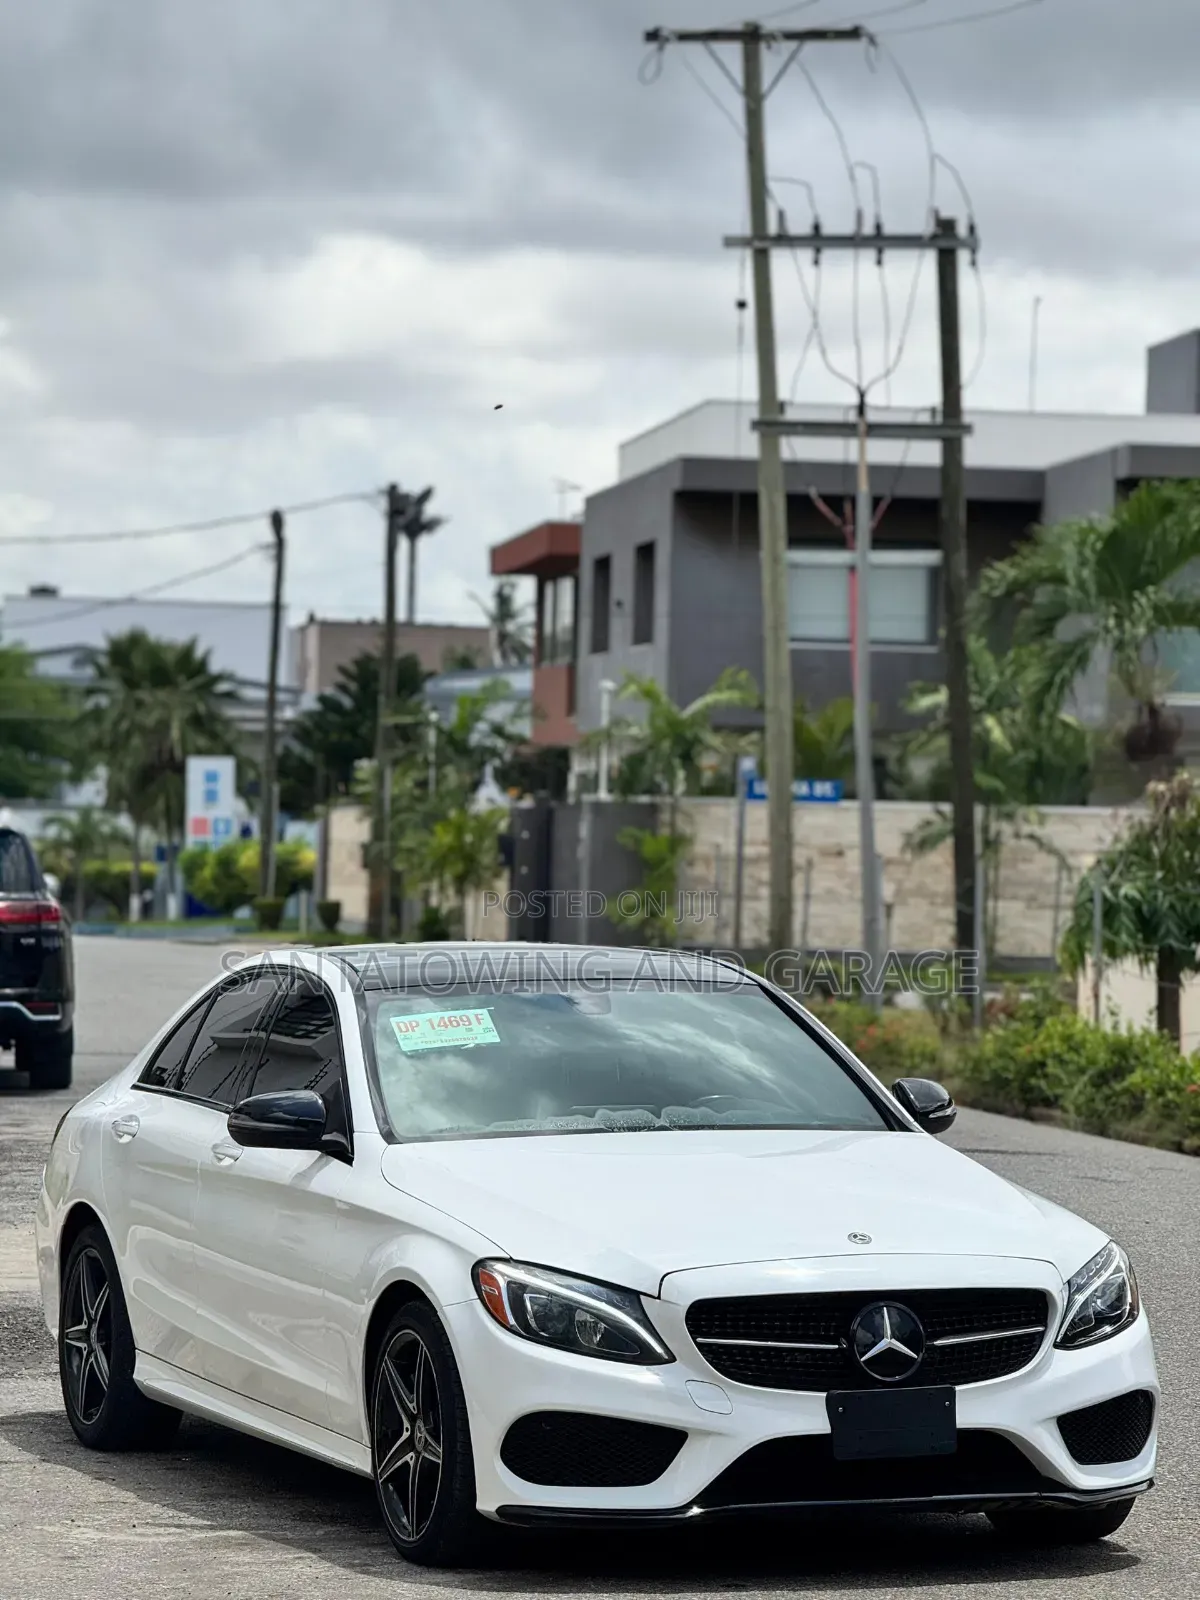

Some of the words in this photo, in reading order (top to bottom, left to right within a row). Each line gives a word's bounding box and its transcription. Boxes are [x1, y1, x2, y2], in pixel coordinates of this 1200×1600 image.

[395, 1020, 420, 1033] DP
[426, 1014, 472, 1031] 1469
[474, 1013, 484, 1026] F
